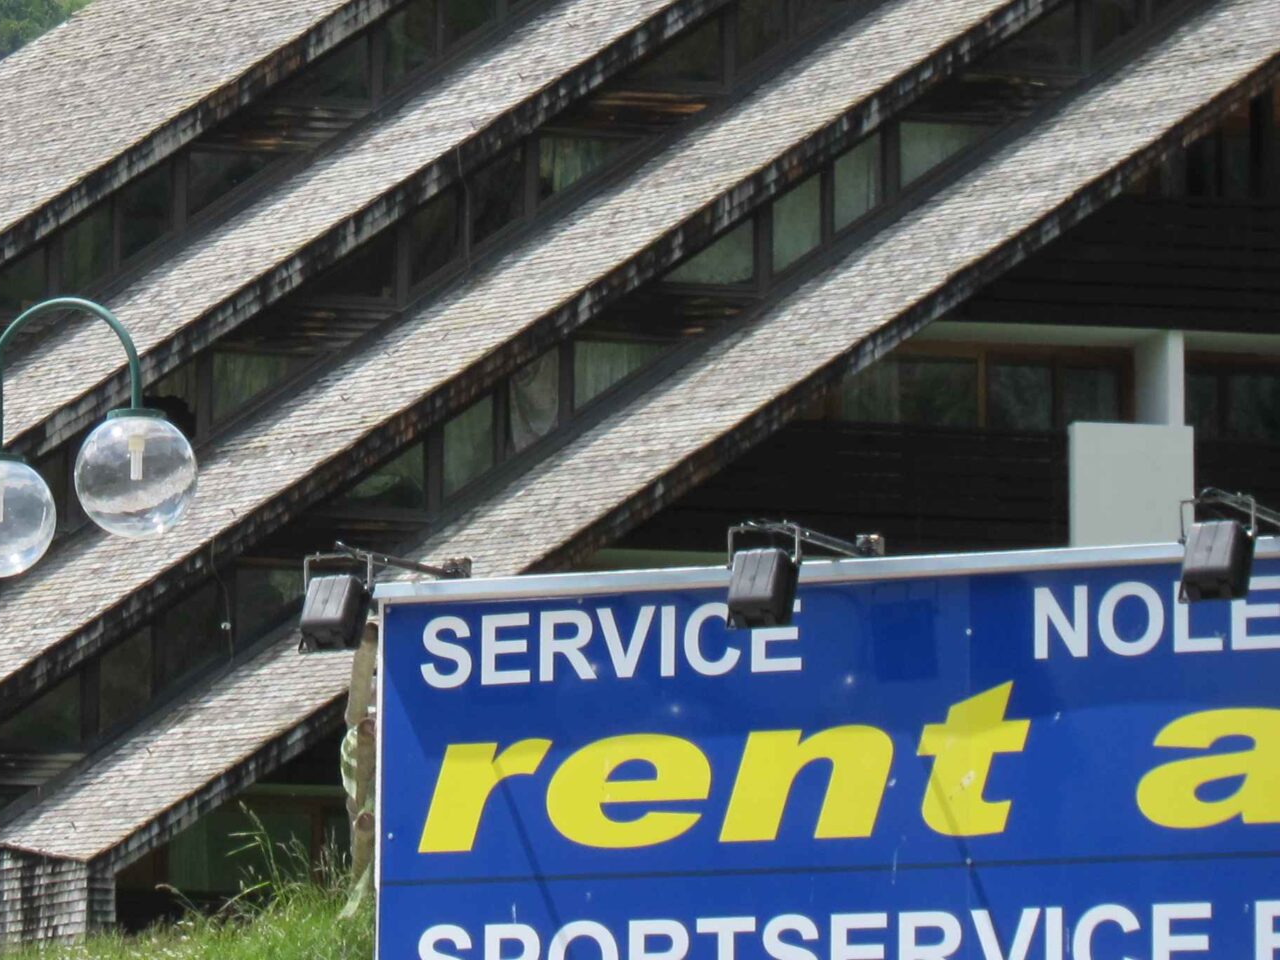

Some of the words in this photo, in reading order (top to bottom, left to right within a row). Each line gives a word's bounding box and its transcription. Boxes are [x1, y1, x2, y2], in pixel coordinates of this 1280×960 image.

[420, 600, 802, 689] SERVICE
[417, 680, 1031, 854] rent
[1136, 707, 1280, 829] a
[418, 902, 1212, 960] SPORTSERVICE
